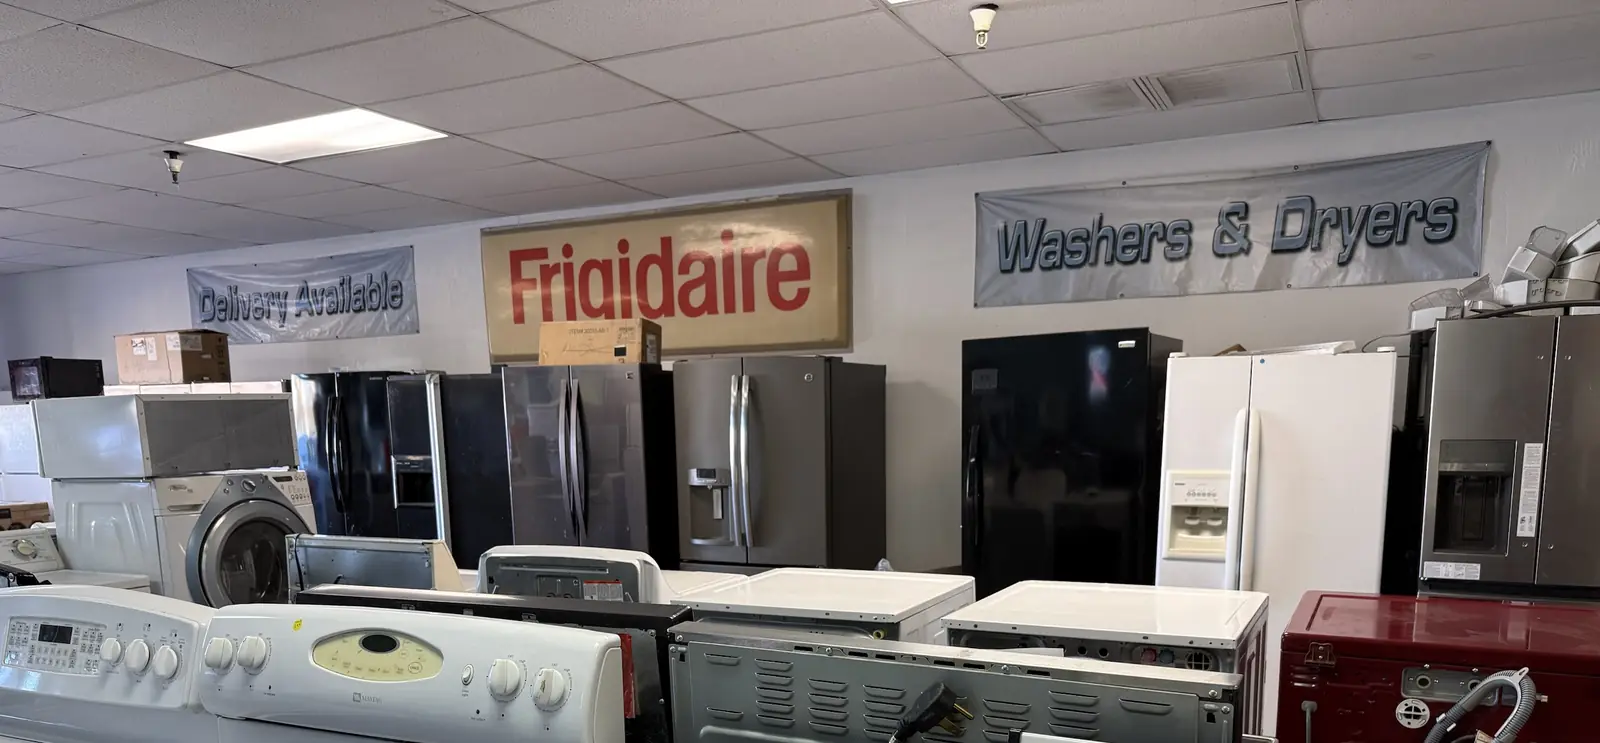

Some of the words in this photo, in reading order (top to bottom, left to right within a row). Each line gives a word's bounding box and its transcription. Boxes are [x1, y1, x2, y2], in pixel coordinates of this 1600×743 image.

[998, 214, 1192, 273] Washers
[1212, 201, 1249, 257] &
[1271, 196, 1457, 265] Dryers
[201, 285, 288, 328] Delivery
[295, 272, 403, 317] Available
[509, 229, 811, 325] Frigidaire
